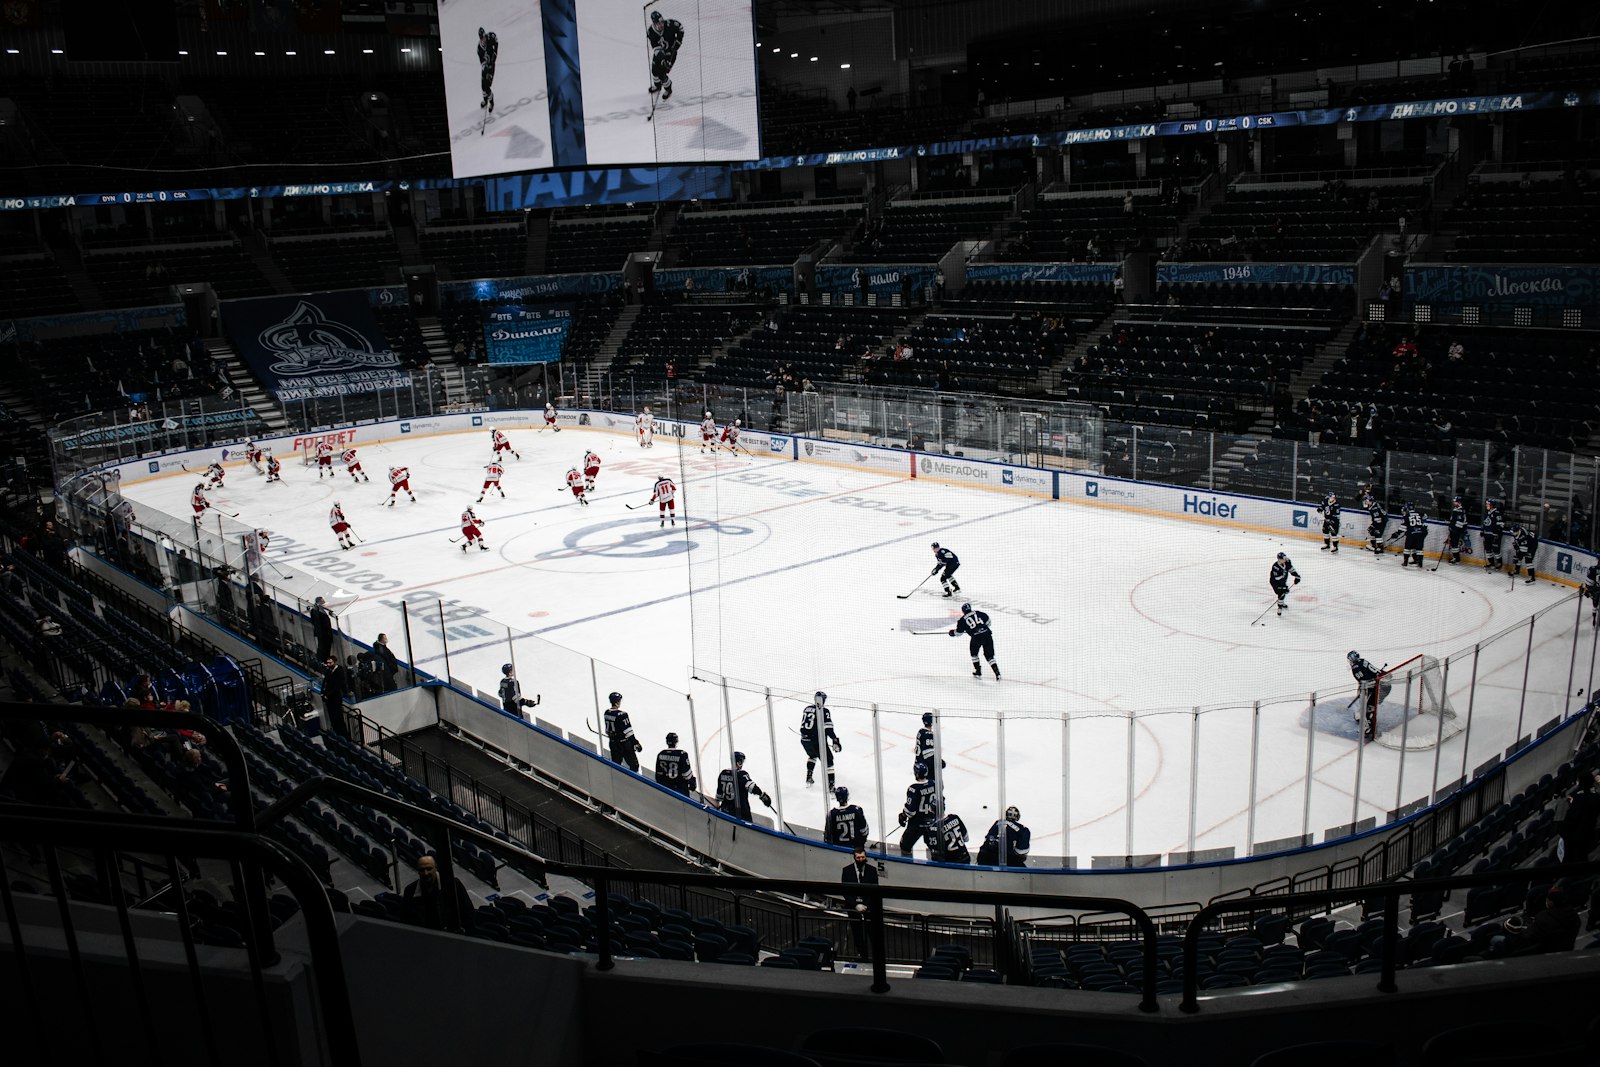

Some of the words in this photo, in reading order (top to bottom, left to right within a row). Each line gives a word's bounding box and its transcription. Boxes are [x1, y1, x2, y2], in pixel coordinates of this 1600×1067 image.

[1391, 102, 1457, 119] ДИНАМО
[1478, 95, 1522, 111] ЦСКА
[1184, 124, 1197, 132] DYN
[1205, 120, 1213, 131] 0
[1242, 118, 1250, 128] 0
[1258, 117, 1272, 125] CSK
[1065, 129, 1111, 144] ДИНАМО
[1125, 125, 1156, 138] ЦСКА
[826, 152, 866, 164] ДИНАМО
[876, 149, 898, 159] ЦСКА
[284, 184, 329, 196] ДИНАМО
[343, 181, 374, 193] ЦСКА
[102, 195, 116, 203] DYN
[124, 193, 132, 203] 0
[159, 191, 167, 201] 0
[851, 268, 900, 289] Днамо
[1222, 266, 1251, 281] 1946
[536, 281, 559, 294] 1946
[1487, 273, 1564, 297] Москва
[497, 313, 512, 321] ВТБ
[526, 311, 541, 319] ВТБ
[555, 310, 570, 318] ВТБ
[491, 326, 562, 341] Динамо
[653, 421, 686, 438] HL.RU
[740, 437, 748, 445] THE
[749, 437, 759, 445] BEST
[760, 438, 769, 446] RUN
[771, 439, 785, 451] SAP
[661, 484, 669, 494] 11
[1099, 486, 1135, 498] /dynamo_ru
[1183, 493, 1238, 519] Haier
[1409, 515, 1423, 527] 55
[965, 613, 984, 629] 94
[720, 781, 735, 801] 79
[836, 812, 856, 822] ALANOV
[836, 820, 855, 842] 21
[943, 825, 965, 851] 25
[877, 862, 885, 872] 5
